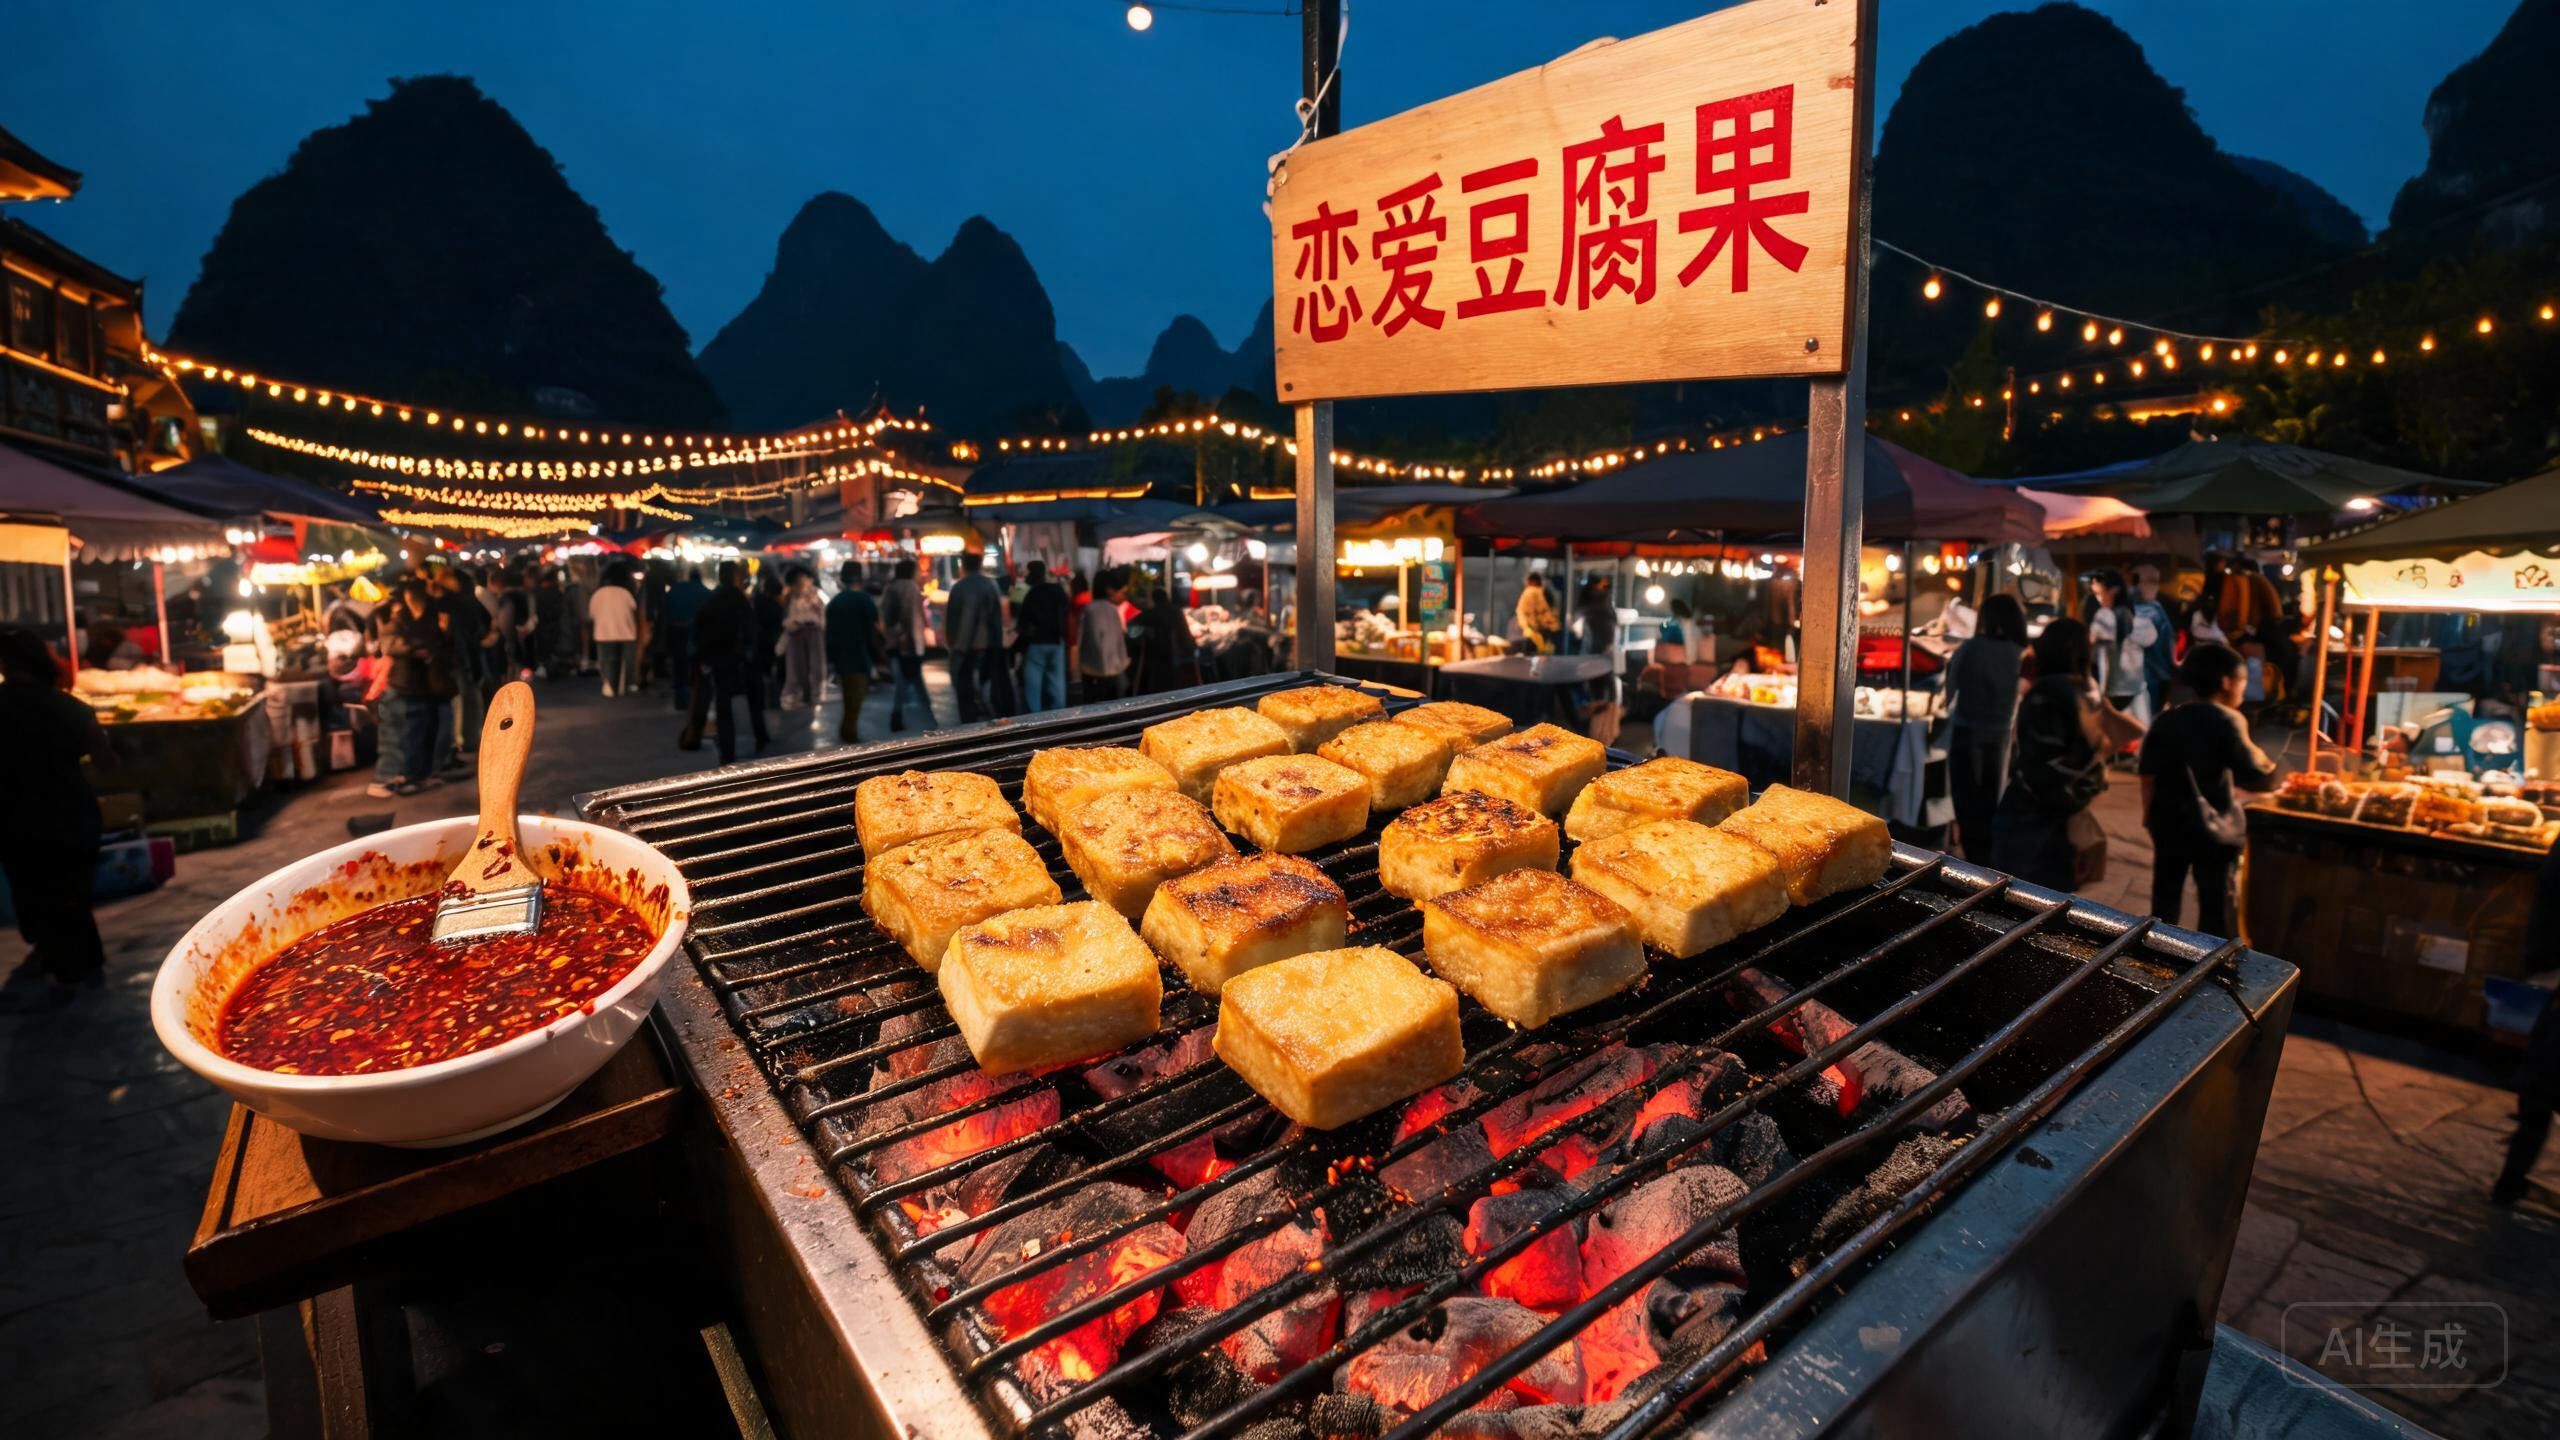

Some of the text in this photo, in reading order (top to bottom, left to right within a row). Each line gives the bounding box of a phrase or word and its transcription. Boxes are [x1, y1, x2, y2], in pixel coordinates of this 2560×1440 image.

[1292, 84, 1809, 343] 恋爱豆腐果
